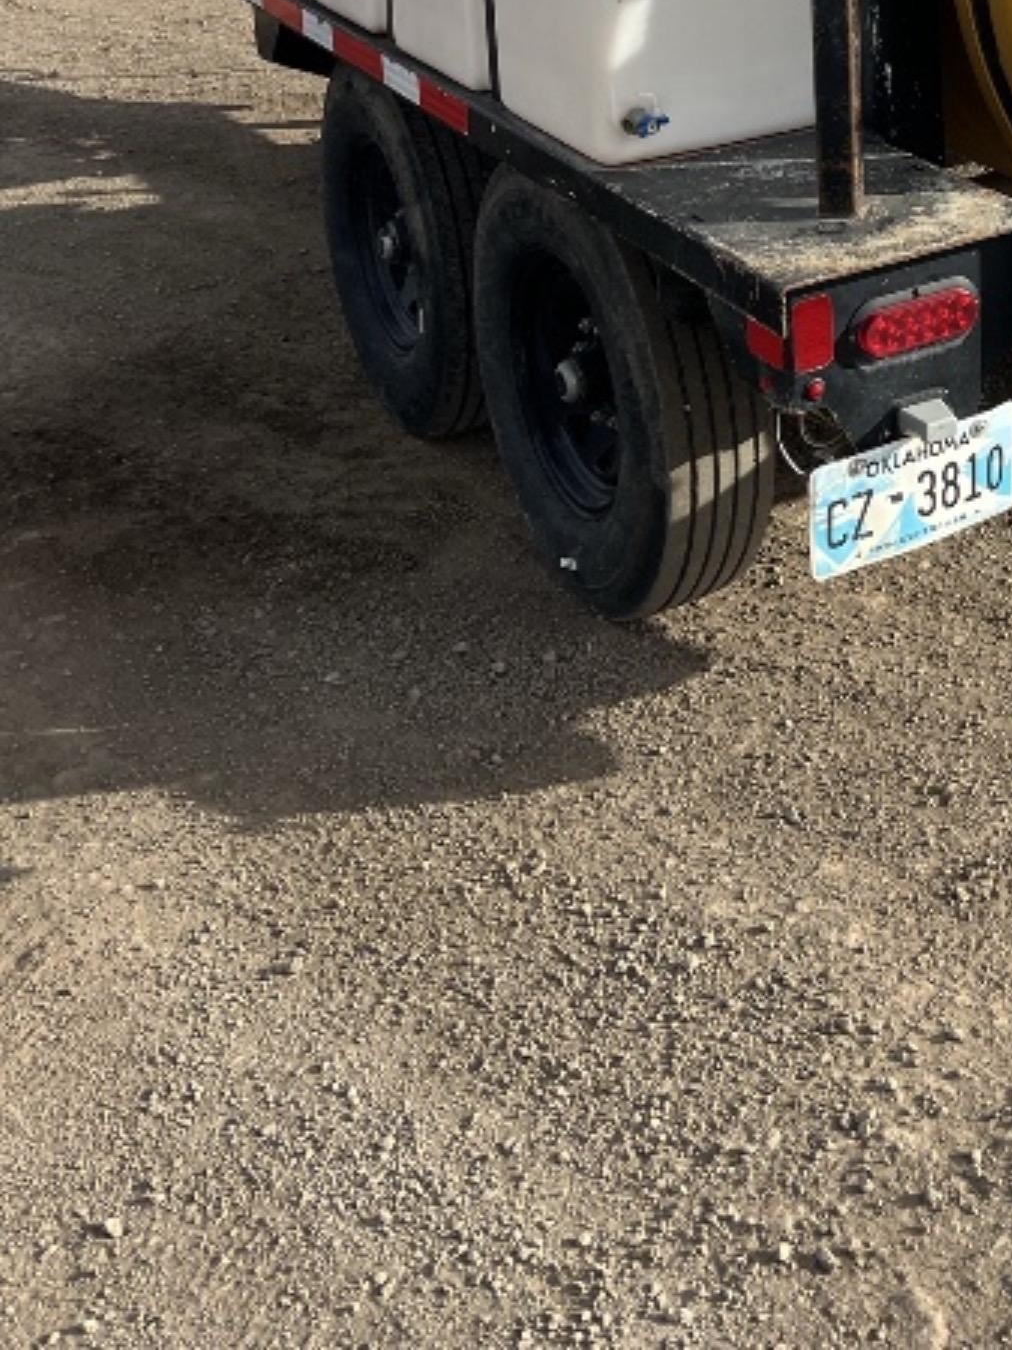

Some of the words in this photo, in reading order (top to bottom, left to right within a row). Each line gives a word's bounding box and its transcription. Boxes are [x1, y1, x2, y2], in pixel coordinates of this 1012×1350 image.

[865, 432, 970, 478] OKLAHOMA
[826, 488, 874, 550] CZ
[917, 444, 1004, 517] 3810
